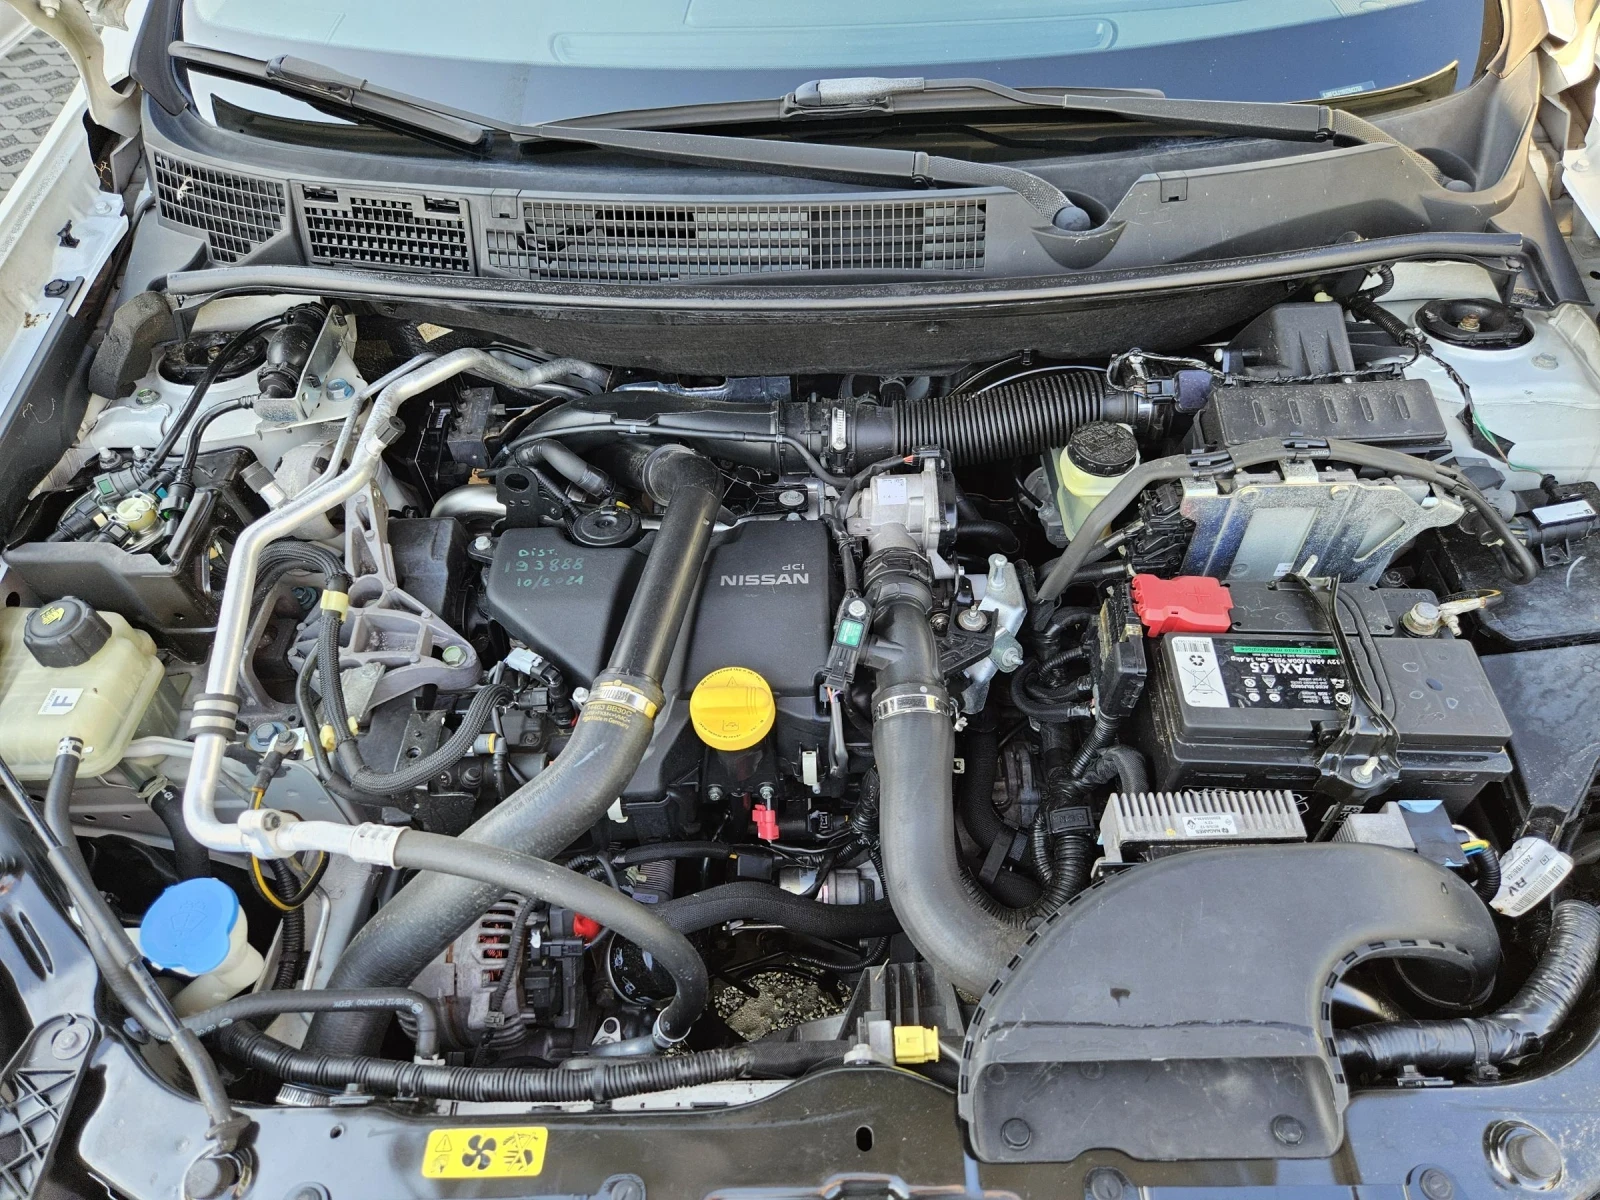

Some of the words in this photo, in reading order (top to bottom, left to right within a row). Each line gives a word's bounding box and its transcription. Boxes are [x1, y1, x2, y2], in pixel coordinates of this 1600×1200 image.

[781, 563, 805, 571] dCi
[720, 572, 809, 586] NISSAN
[1249, 662, 1269, 673] 65
[1274, 662, 1314, 675] TAXI
[52, 695, 74, 707] F
[1508, 877, 1527, 897] RV
